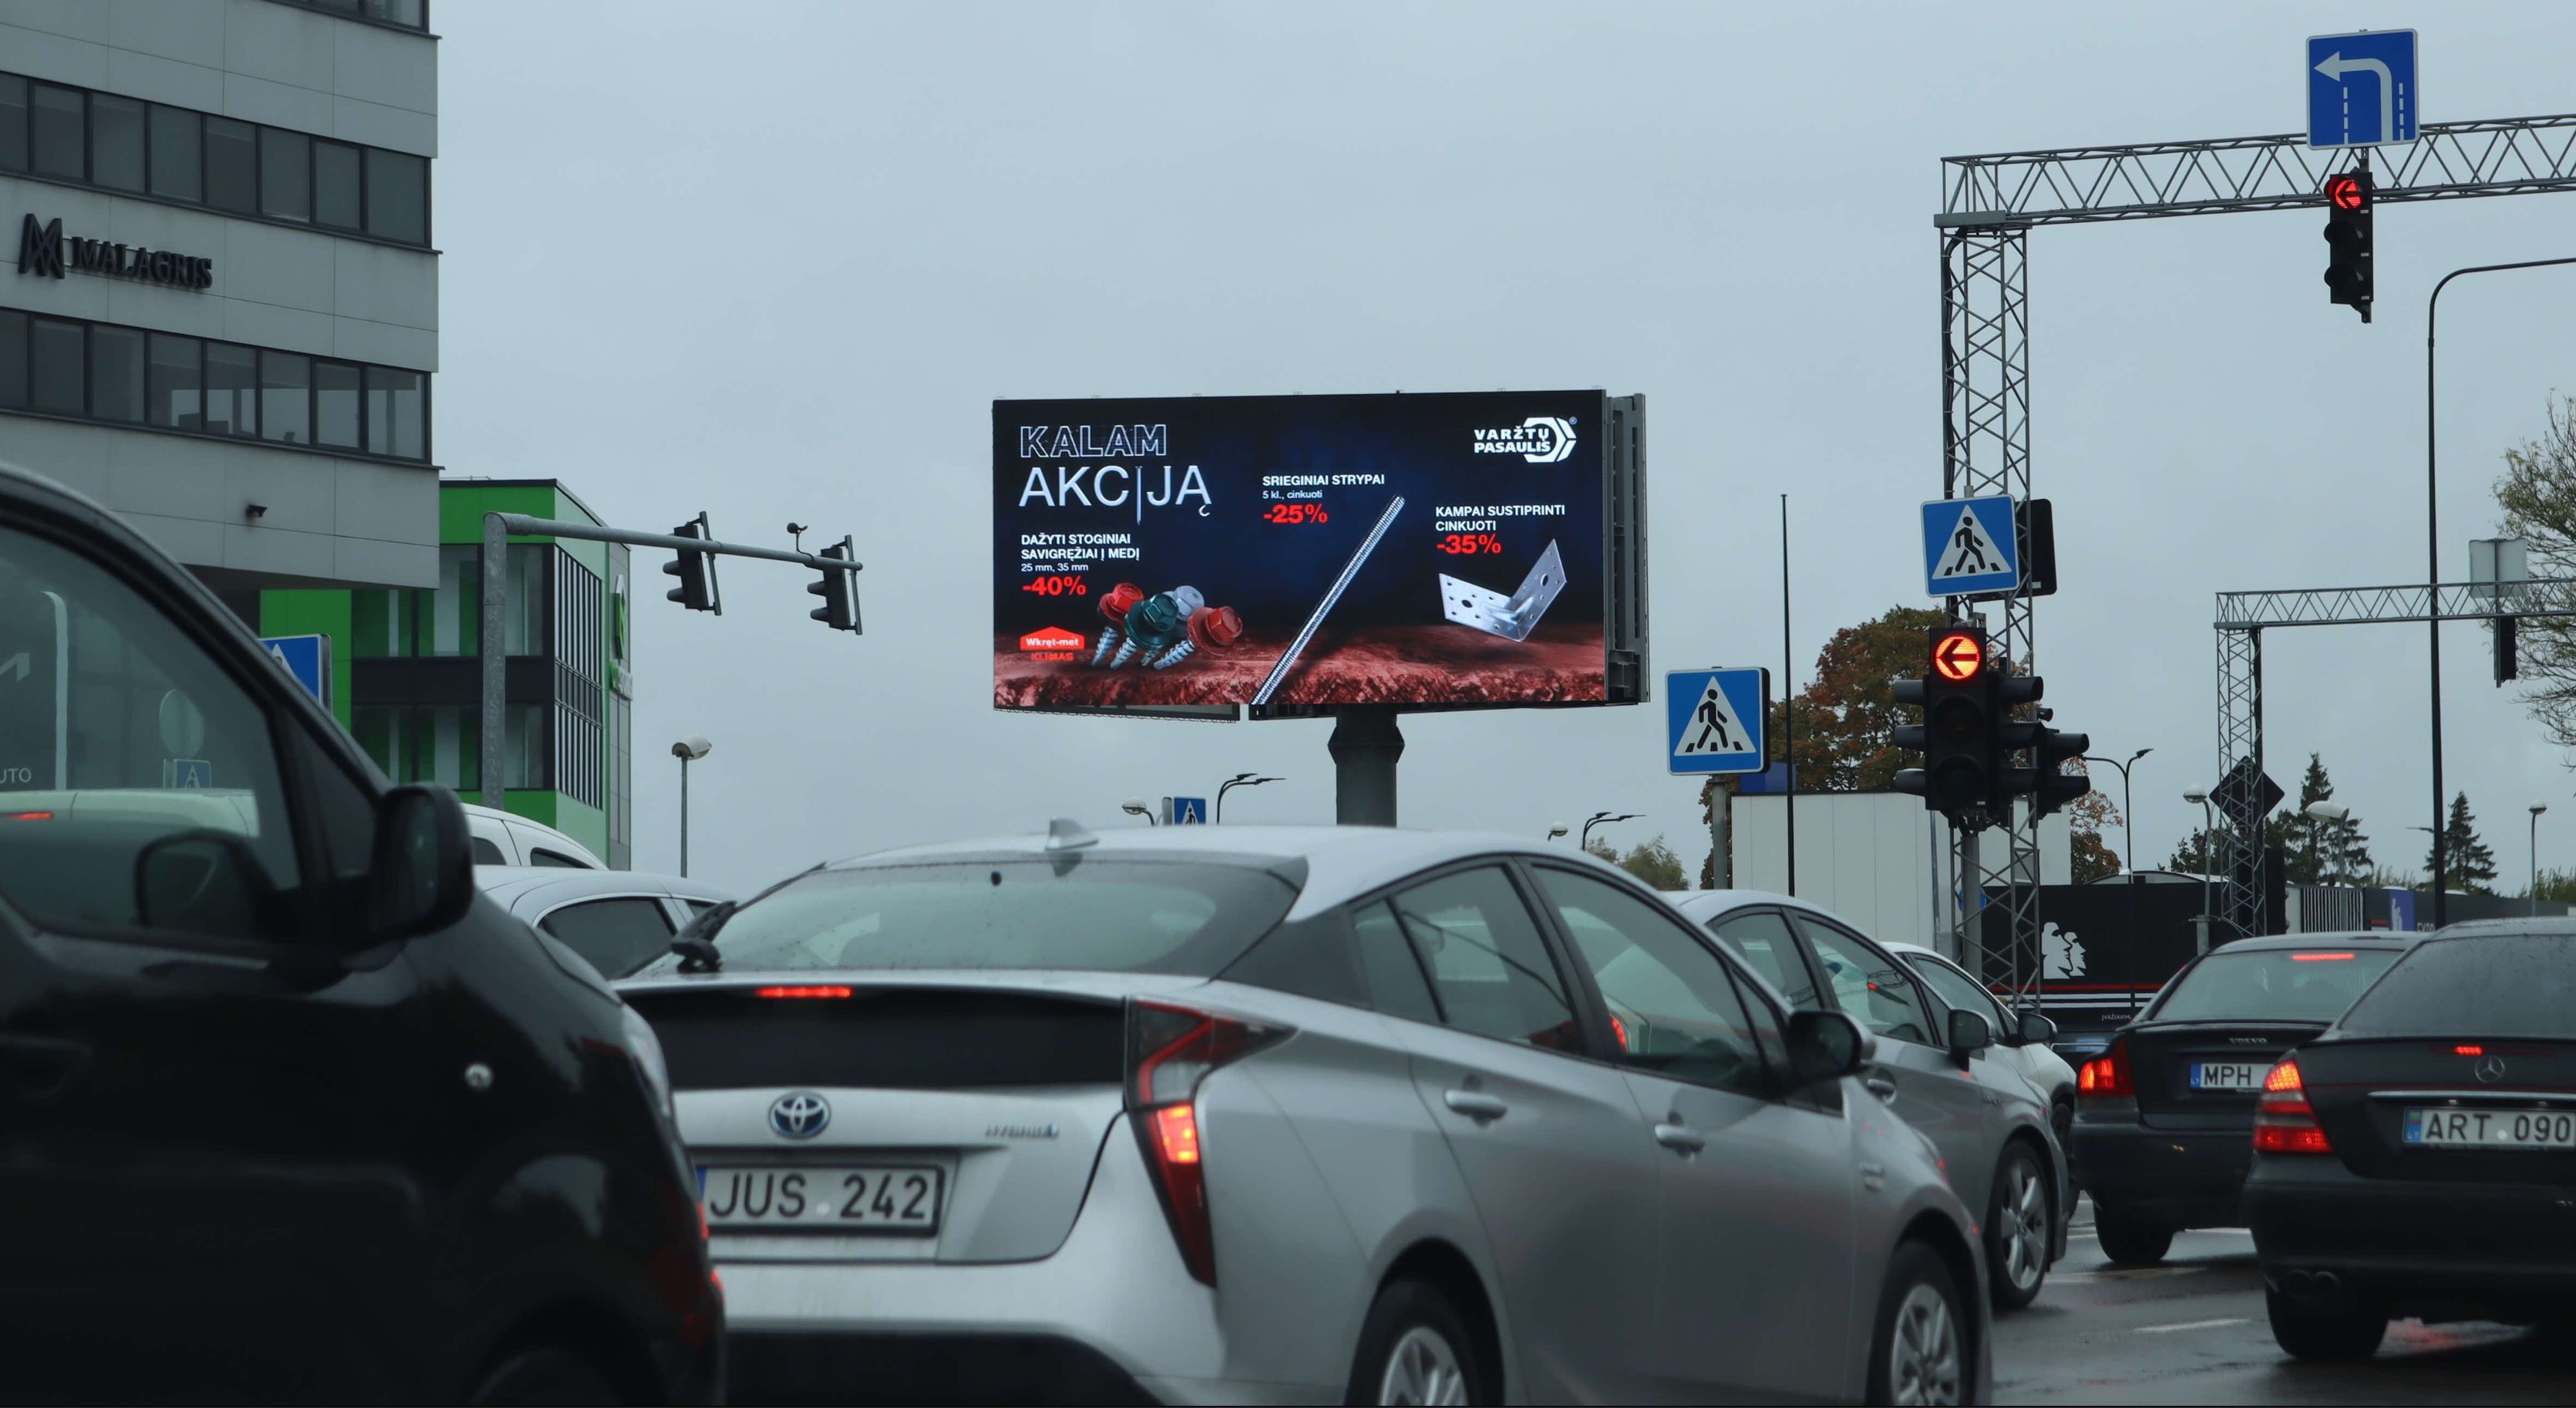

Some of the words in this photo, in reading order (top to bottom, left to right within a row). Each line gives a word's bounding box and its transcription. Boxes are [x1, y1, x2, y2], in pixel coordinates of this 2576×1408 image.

[72, 236, 212, 288] MALAGRIS
[1020, 424, 1167, 458] KALAM
[1474, 426, 1549, 441] VARŽTŲ
[1474, 441, 1550, 453] PASAULIS
[1262, 475, 1329, 486] SRIEGINIAI
[1331, 474, 1385, 485] STRYPAI
[1262, 490, 1269, 499] 5
[1287, 490, 1323, 499] cinkuoti
[1264, 503, 1328, 524] -25%
[1436, 506, 1484, 516] KAMPAI
[1487, 504, 1565, 516] SUSTIPRINTI
[1435, 520, 1496, 531] CINKUOTI
[1021, 532, 1066, 545] DAŽYTI
[1068, 533, 1131, 545] STOGINIAI
[1436, 533, 1502, 555] -35%
[1021, 546, 1097, 562] SAVIGRĘŽIAI
[1101, 548, 1105, 561] Į
[1108, 547, 1140, 561] MEDĮ
[1021, 563, 1033, 572] 25
[1058, 563, 1069, 571] 35
[1023, 576, 1086, 596] -40%
[1026, 638, 1079, 647] Wkręt-met
[2204, 1066, 2252, 1086] MPH
[2425, 1113, 2492, 1140] ART
[2514, 1114, 2571, 1142] 090
[709, 1173, 806, 1219] JUS
[840, 1173, 929, 1220] 242
